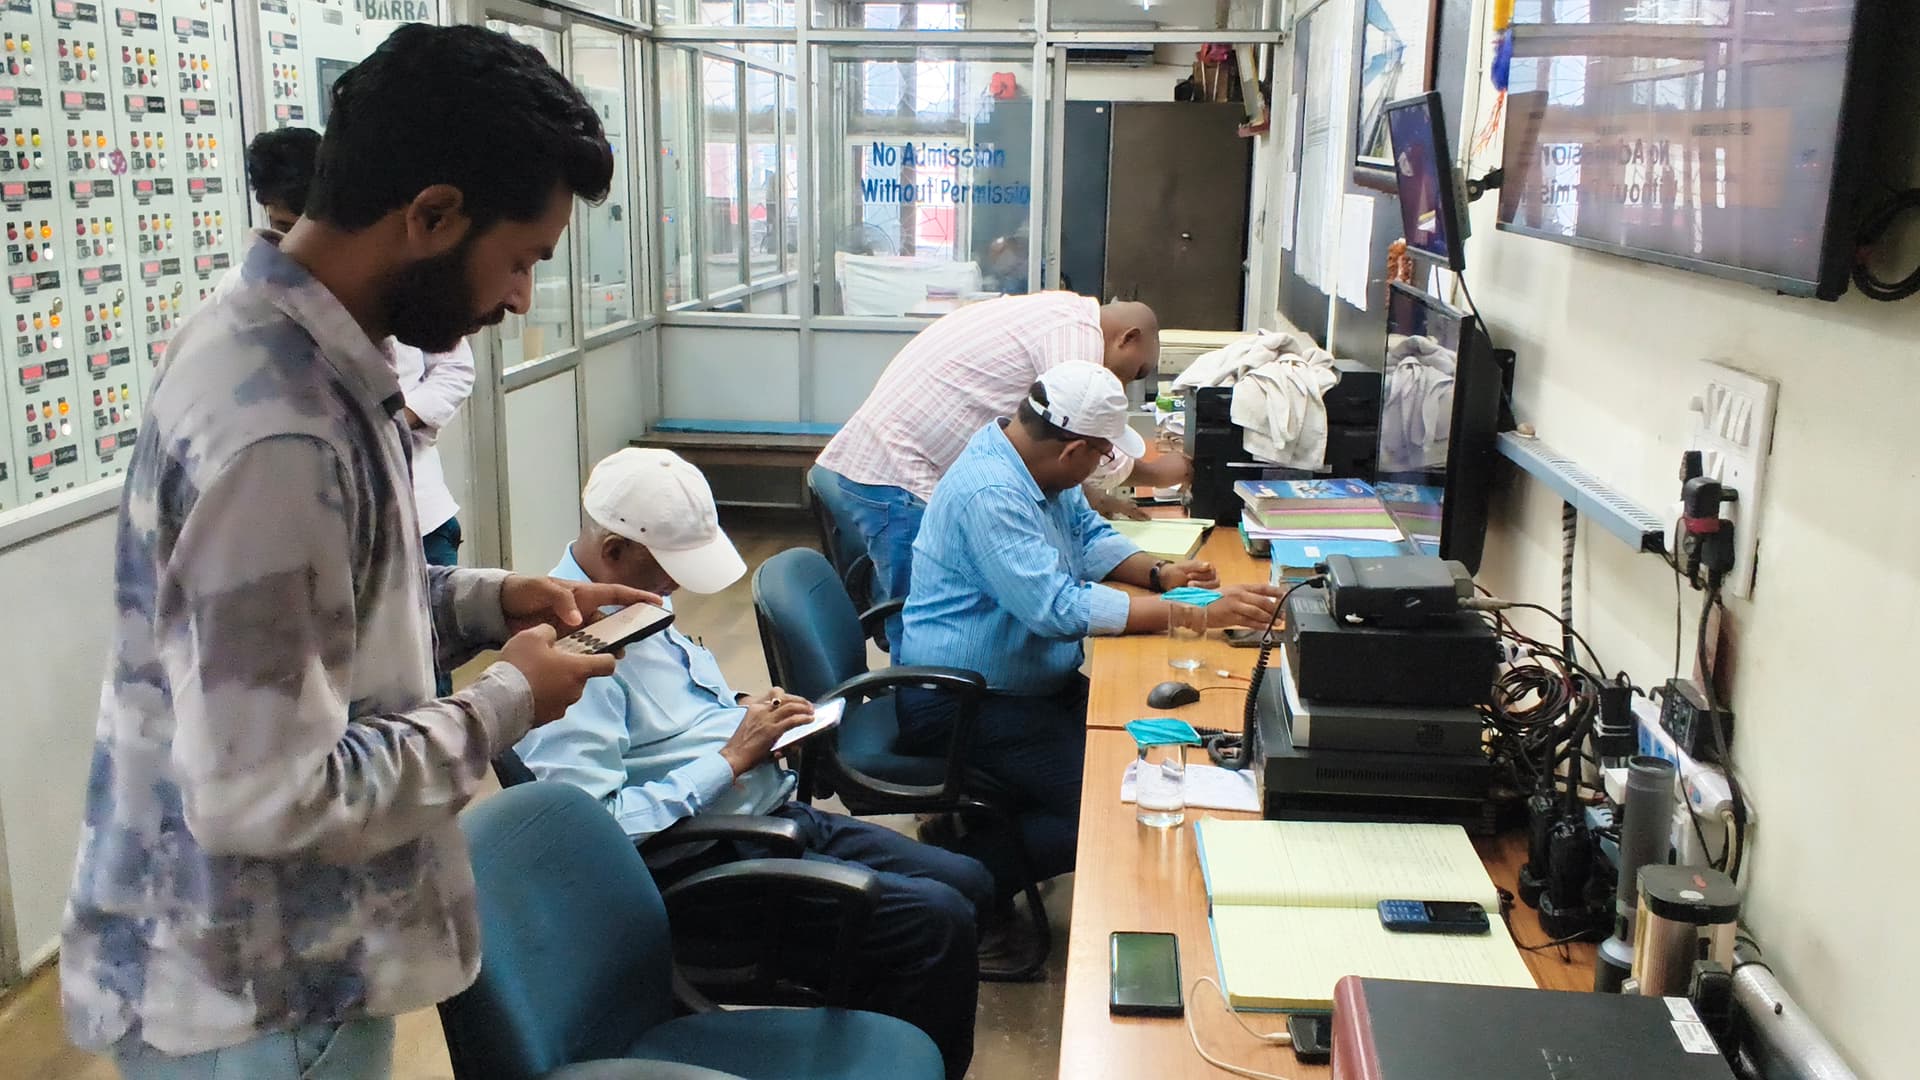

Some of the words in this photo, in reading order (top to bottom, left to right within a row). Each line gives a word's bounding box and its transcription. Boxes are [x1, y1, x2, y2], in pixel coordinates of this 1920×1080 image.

[365, 0, 429, 20] BARRA
[872, 142, 896, 167] No
[901, 142, 1005, 168] Admission
[861, 177, 933, 203] Without
